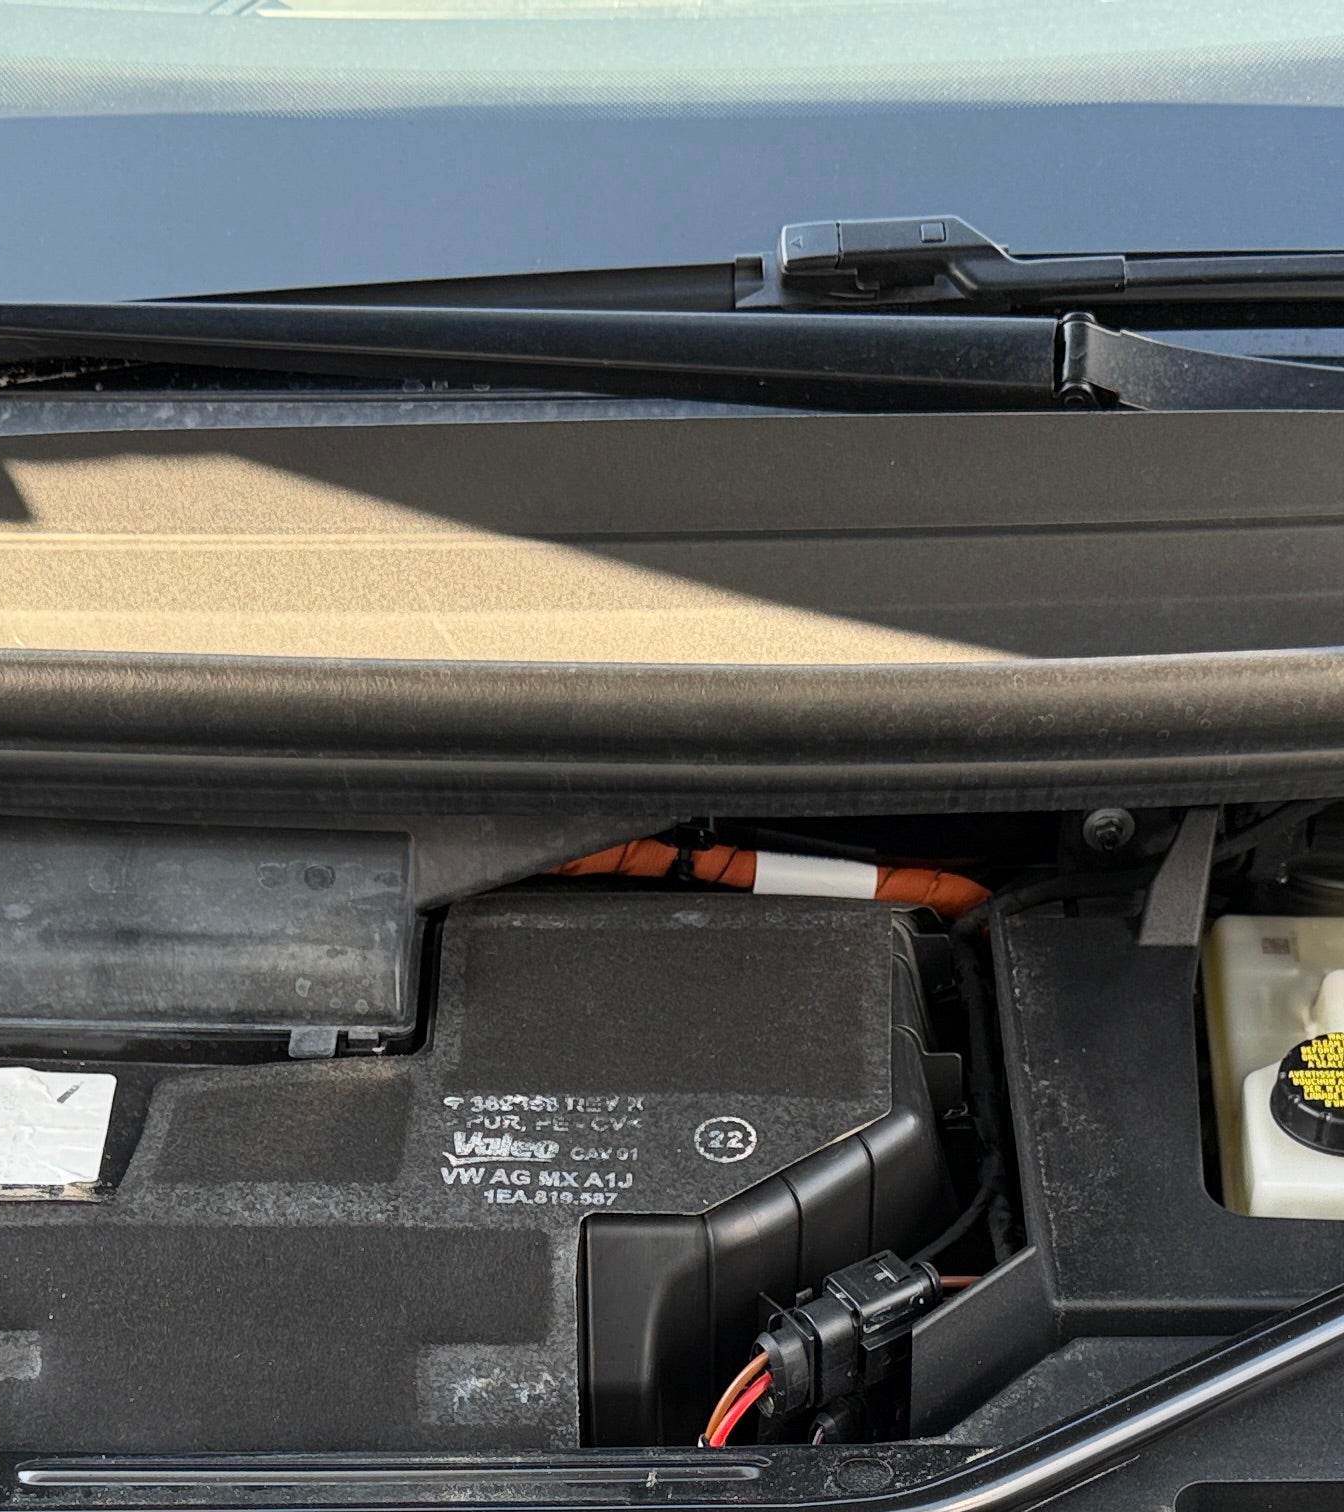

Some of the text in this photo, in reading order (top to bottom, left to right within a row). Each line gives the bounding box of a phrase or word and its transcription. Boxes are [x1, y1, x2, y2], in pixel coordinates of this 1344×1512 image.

[453, 1131, 560, 1159] Valeo
[707, 1131, 745, 1149] 22
[617, 1147, 638, 1160] 01
[440, 1167, 486, 1185] VW
[489, 1168, 531, 1186] AG
[538, 1170, 579, 1187] MX
